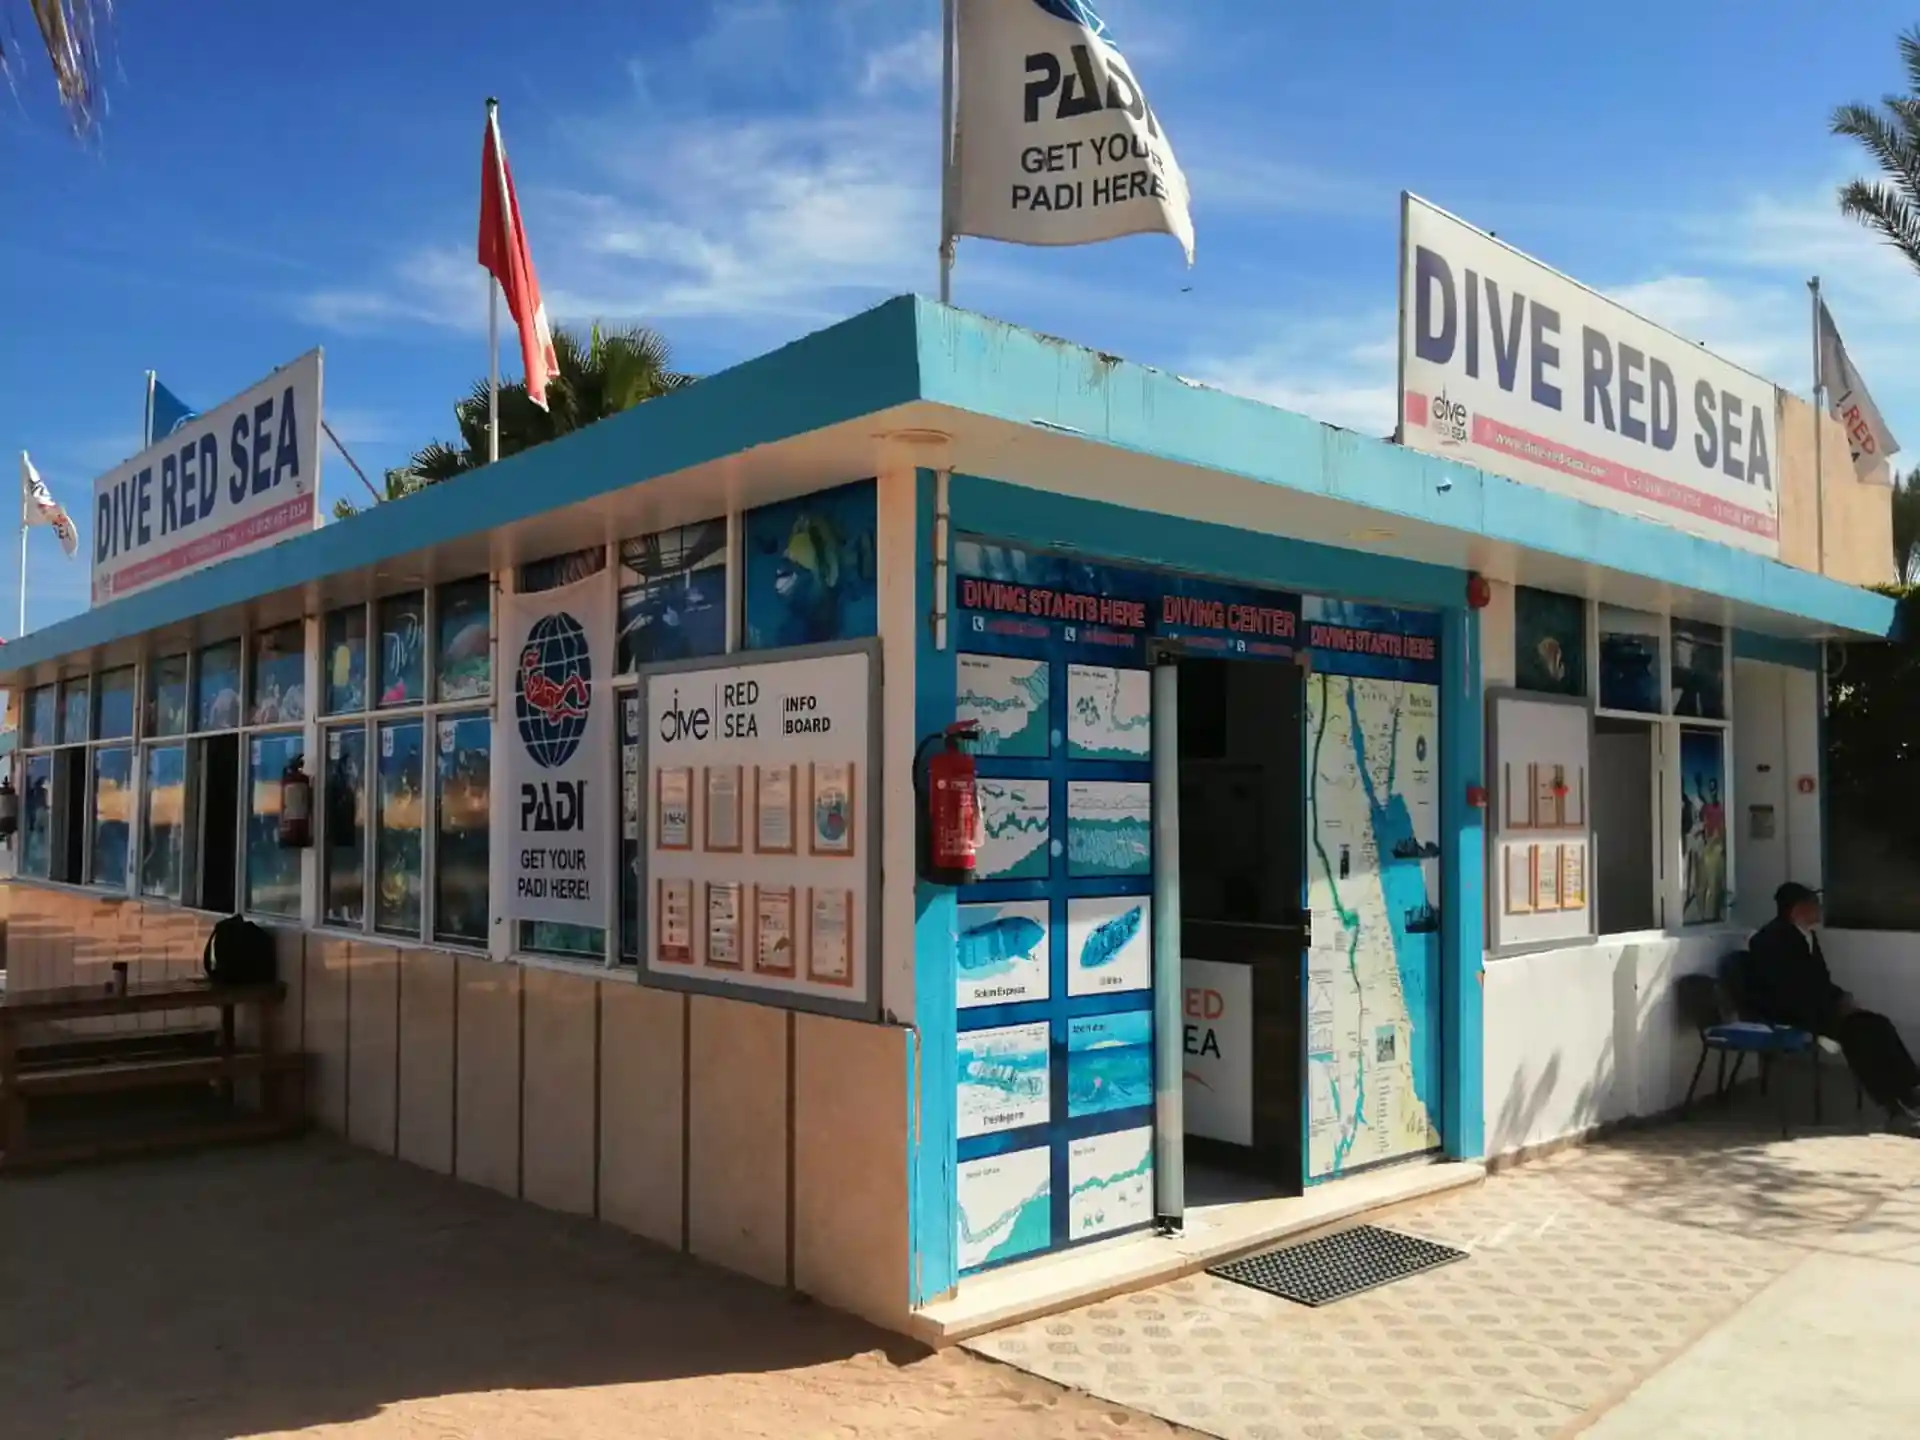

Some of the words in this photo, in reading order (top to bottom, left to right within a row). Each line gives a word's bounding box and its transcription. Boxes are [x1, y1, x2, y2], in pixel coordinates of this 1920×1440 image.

[1021, 141, 1083, 174] GET
[1090, 133, 1165, 175] YOUR
[1012, 181, 1083, 212] PADI
[1415, 244, 1562, 412] DIVE
[1582, 324, 1678, 452] RED
[1694, 379, 1772, 491] SEA
[1432, 385, 1467, 427] dive
[1842, 404, 1876, 455] RED
[96, 465, 152, 565] DIVE
[160, 432, 218, 536] RED
[229, 385, 299, 504] SEA
[963, 580, 1027, 613] DIVING
[1028, 588, 1098, 622] STARTS
[1100, 599, 1146, 628] HERE
[1163, 594, 1226, 629] DIVING
[1227, 604, 1296, 638] CENTER
[724, 680, 759, 708] RED
[785, 696, 818, 712] INFO
[660, 688, 710, 743] dive
[724, 713, 759, 738] SEA
[785, 716, 831, 735] BOARD
[520, 779, 584, 832] PADI
[520, 848, 547, 870] GET
[548, 848, 587, 872] YOUR
[517, 877, 548, 898] PADI
[550, 877, 591, 901] HERE!
[1184, 987, 1224, 1020] ED
[1183, 1024, 1221, 1060] EA
